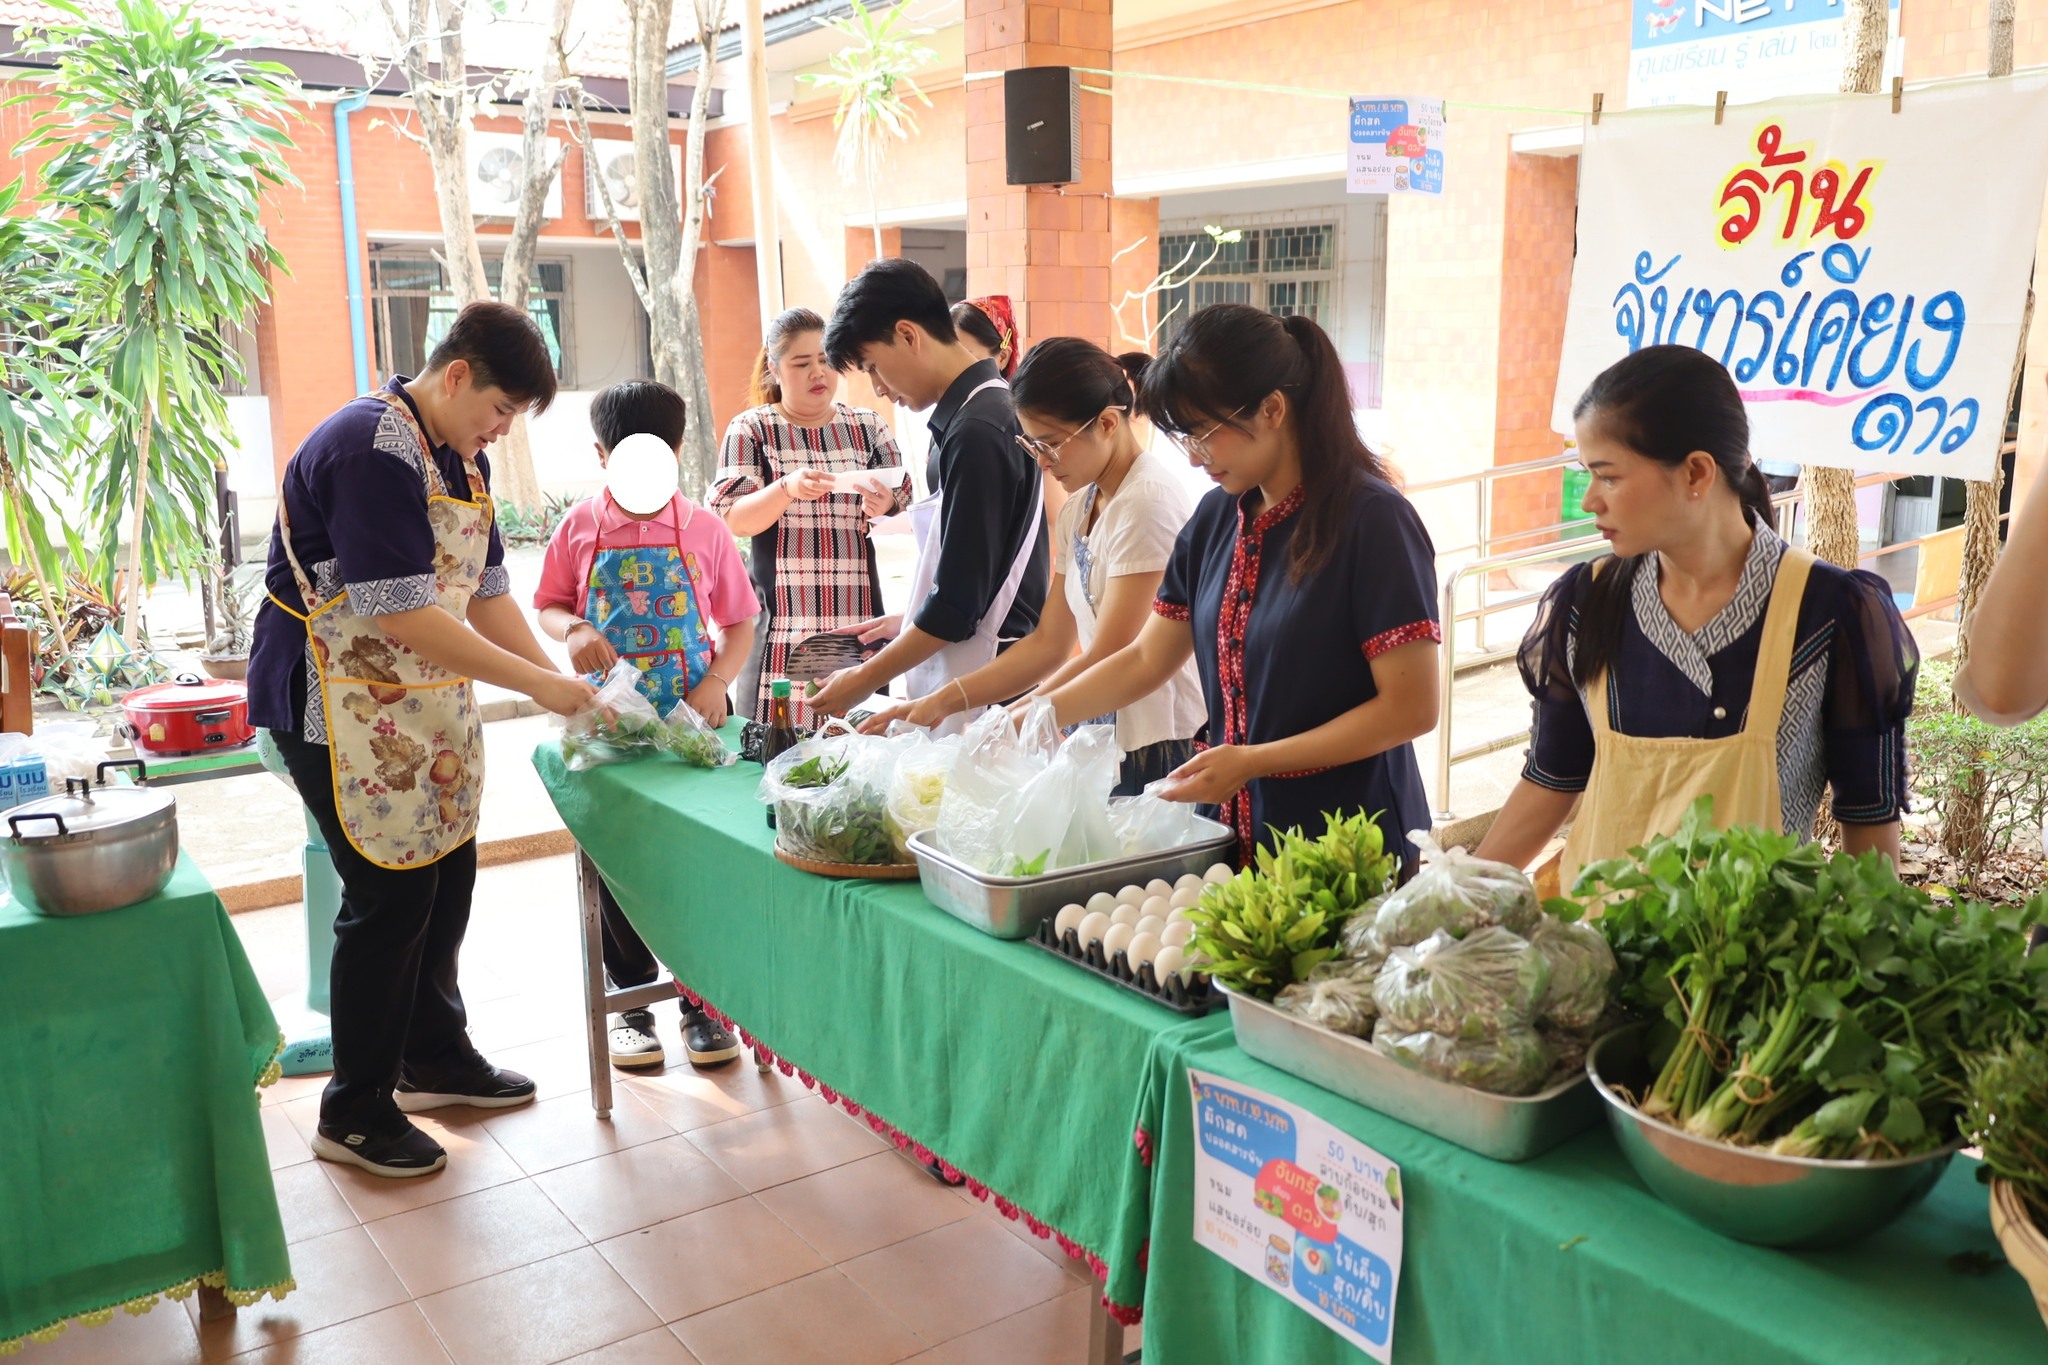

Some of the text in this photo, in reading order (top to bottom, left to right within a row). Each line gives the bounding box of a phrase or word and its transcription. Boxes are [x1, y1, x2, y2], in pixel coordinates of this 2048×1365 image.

[1637, 44, 1727, 83] ศูนย์เรียน
[1735, 35, 1753, 70] รู้
[1758, 31, 1797, 59] เล่น
[1808, 29, 1837, 51] โดย
[1719, 124, 1874, 244] ร้าน
[1851, 392, 1980, 455] ดาว
[17, 770, 45, 786] นม
[1204, 1087, 1211, 1099] 5
[1214, 1091, 1240, 1110] บาท
[1250, 1103, 1261, 1119] 10
[1264, 1110, 1289, 1133] บาท
[1205, 1105, 1247, 1140] ผักสด
[1205, 1132, 1264, 1168] ปลอดสารพิษ
[1328, 1140, 1384, 1187] 50 บาท
[1209, 1177, 1232, 1197] ขนม
[1275, 1160, 1317, 1196] จันทร์
[1209, 1201, 1262, 1239] แสนอร่อย
[1292, 1203, 1323, 1229] ดวง
[1344, 1193, 1387, 1233] ดิบ/สุก
[1334, 1241, 1380, 1290] ไข่เค็ม
[1332, 1301, 1356, 1328] บาท
[1333, 1275, 1386, 1321] สุก/ดิบ
